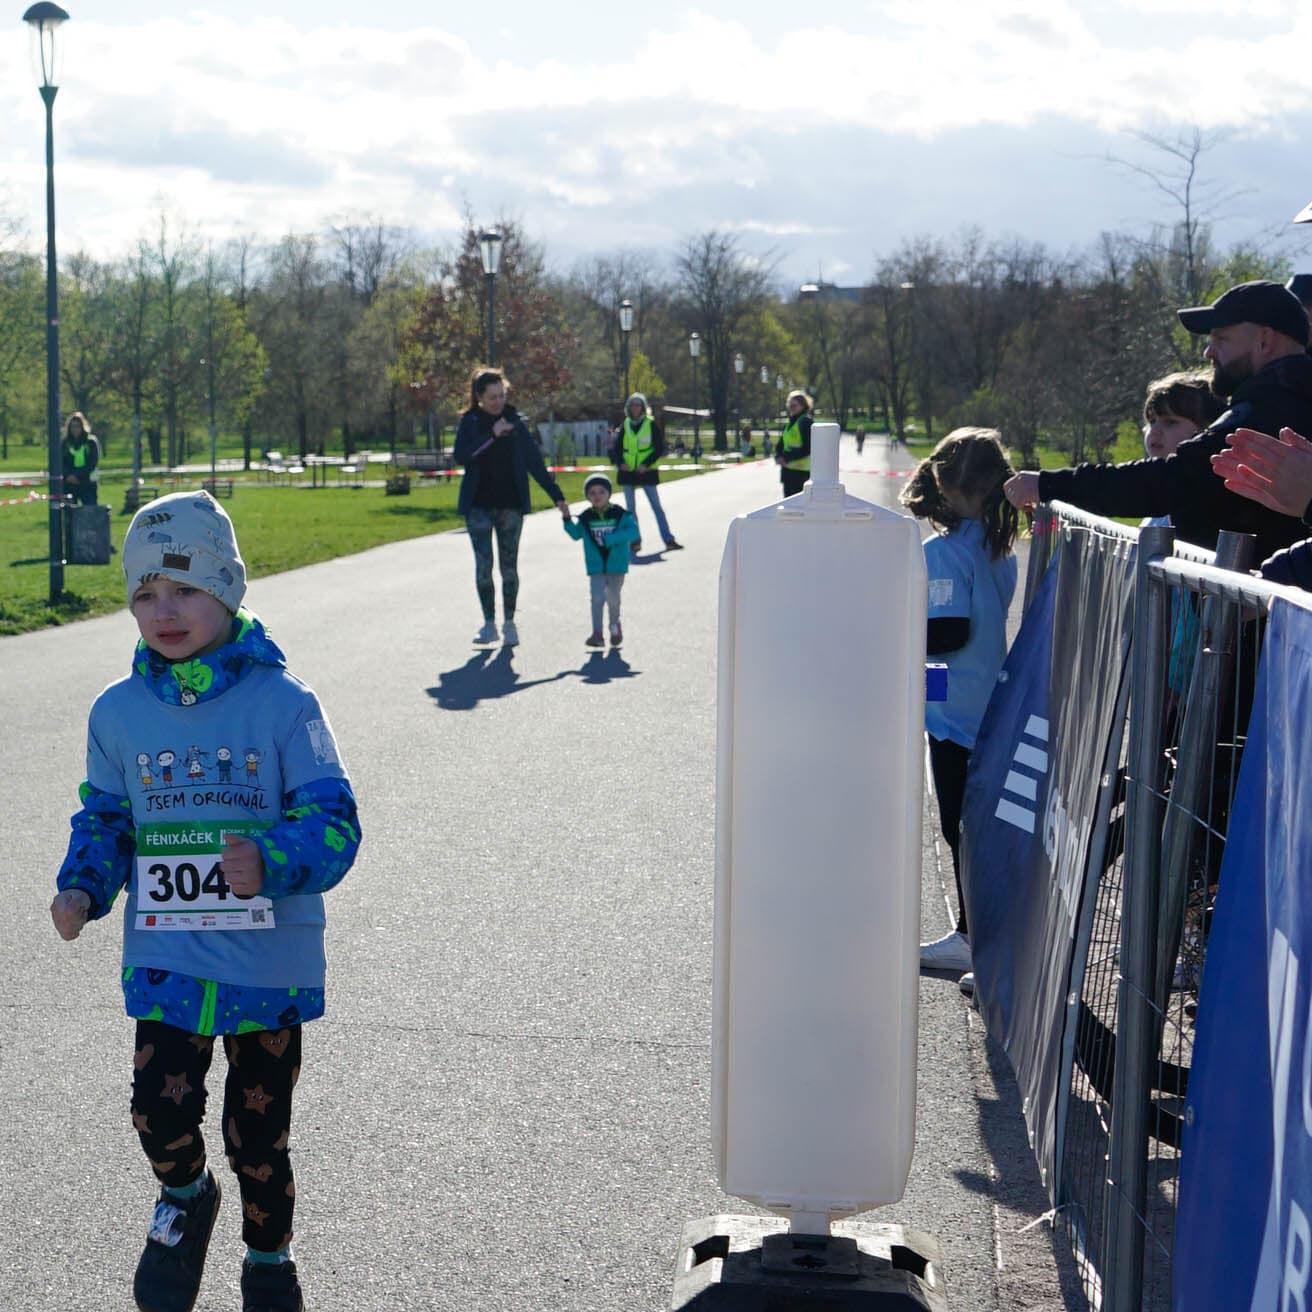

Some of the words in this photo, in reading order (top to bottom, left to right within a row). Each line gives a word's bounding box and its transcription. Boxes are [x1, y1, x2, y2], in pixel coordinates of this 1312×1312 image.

[145, 791, 185, 812] JSEM
[192, 787, 269, 809] ORIGINÁL
[145, 831, 213, 845] FÉNIXÁČEK
[148, 862, 257, 902] 304
